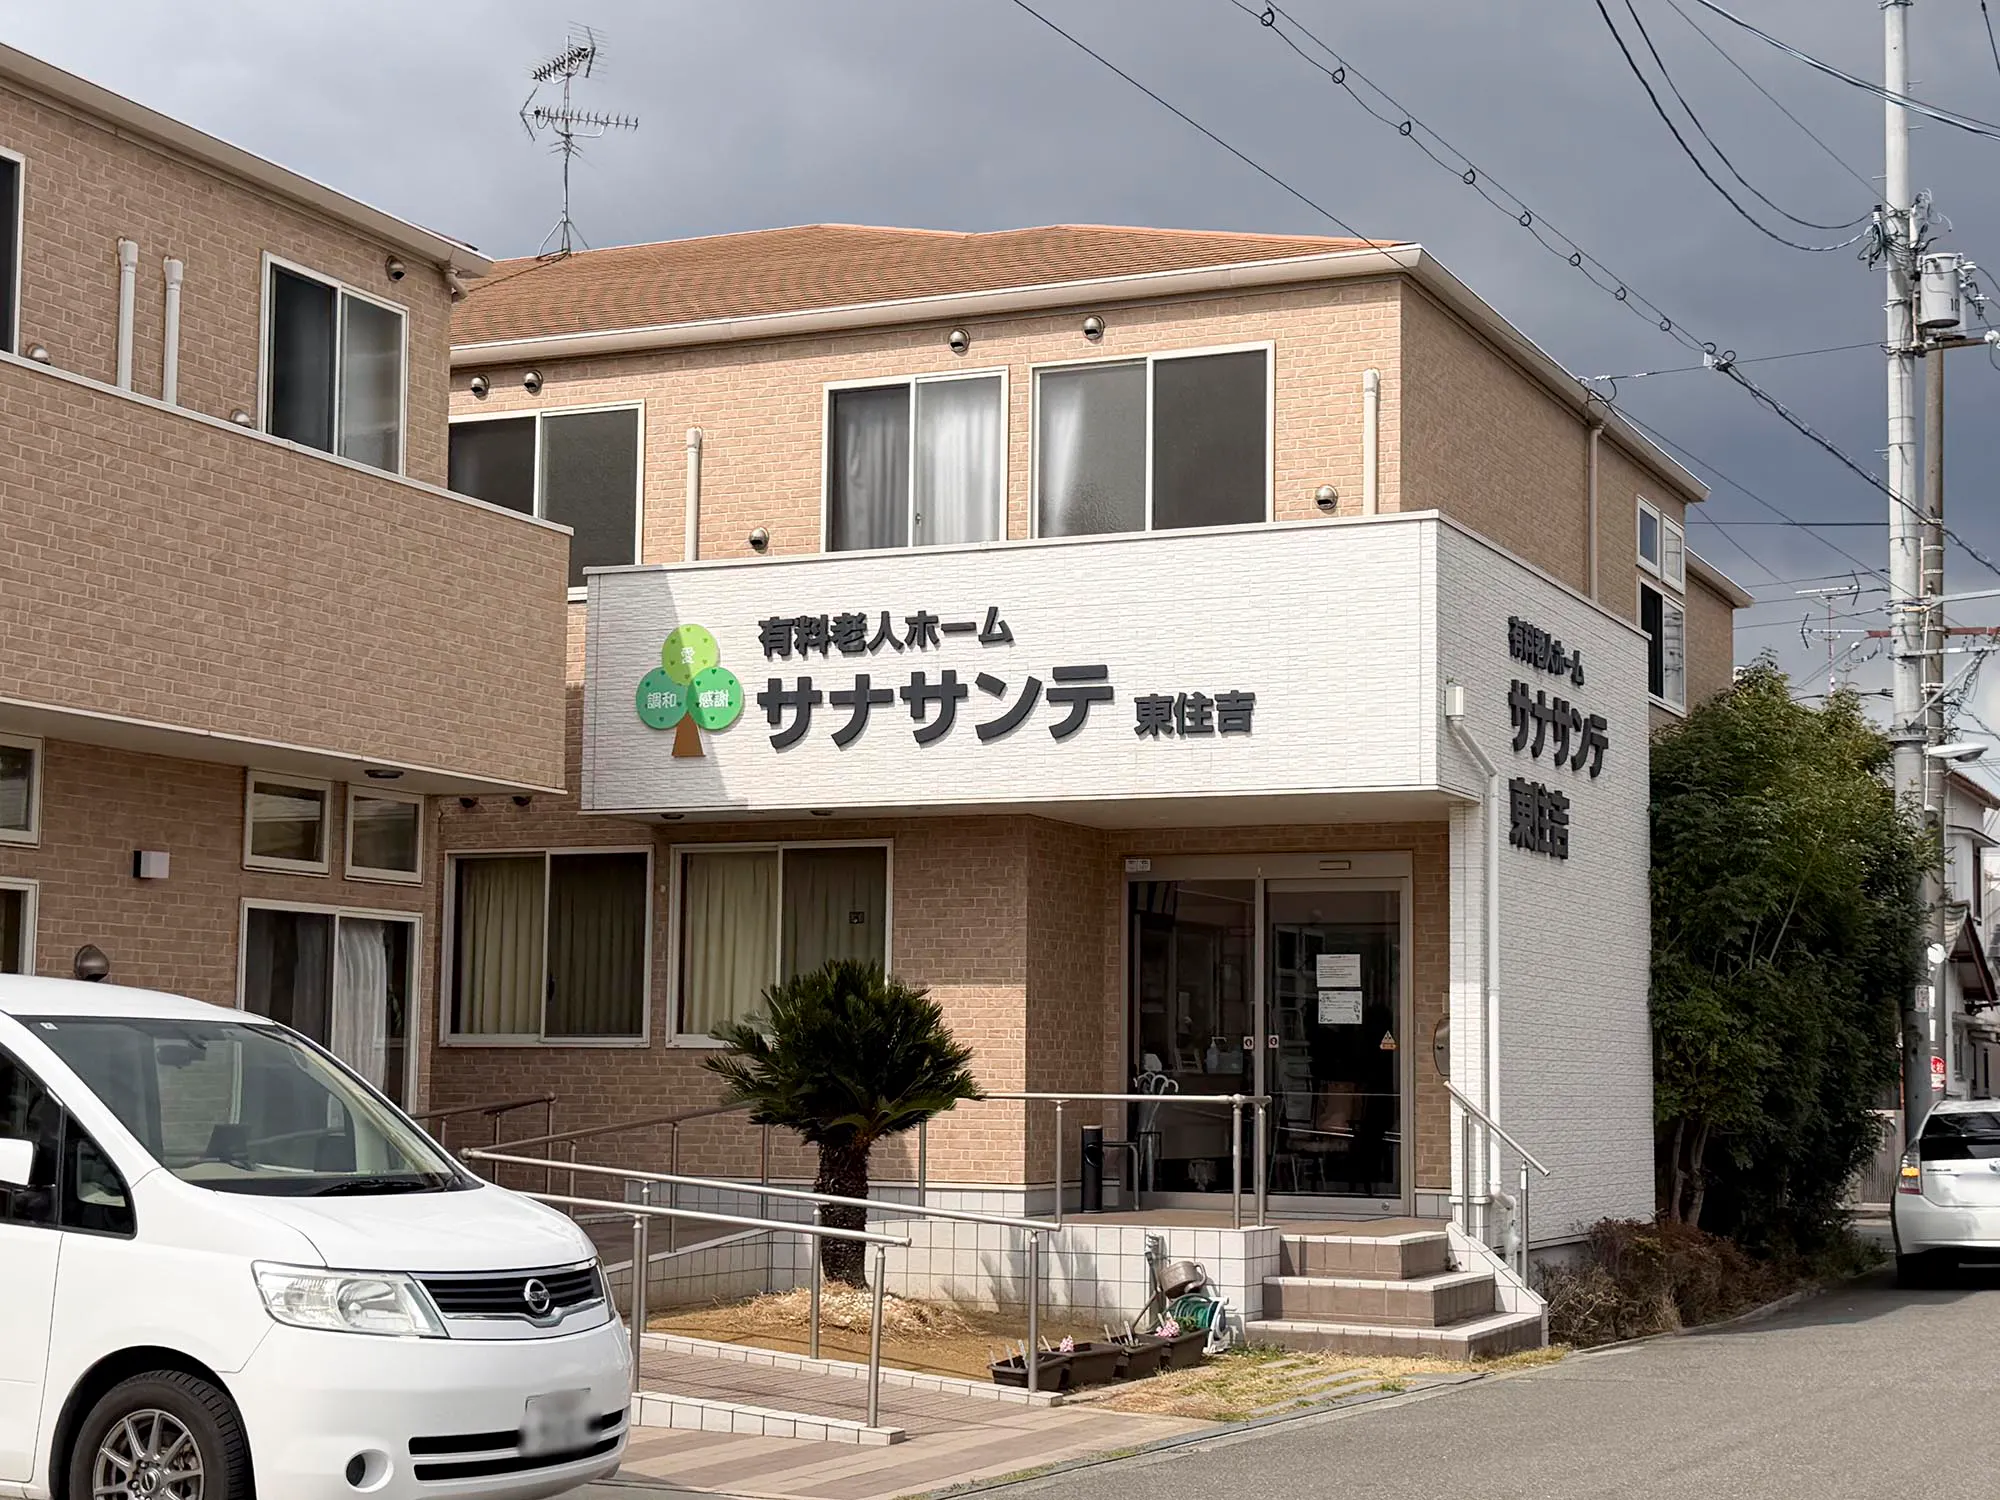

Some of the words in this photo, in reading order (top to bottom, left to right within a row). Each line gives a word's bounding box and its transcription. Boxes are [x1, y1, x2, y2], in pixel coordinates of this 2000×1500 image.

[758, 606, 1014, 657] 有料老人ホーム
[647, 691, 677, 709] 調和
[699, 690, 729, 708] 感謝
[757, 664, 1114, 750] サナサンテ
[1134, 689, 1256, 736] 東住吉
[1508, 679, 1609, 779] サナサンテ
[1508, 777, 1570, 859] 東住吉
